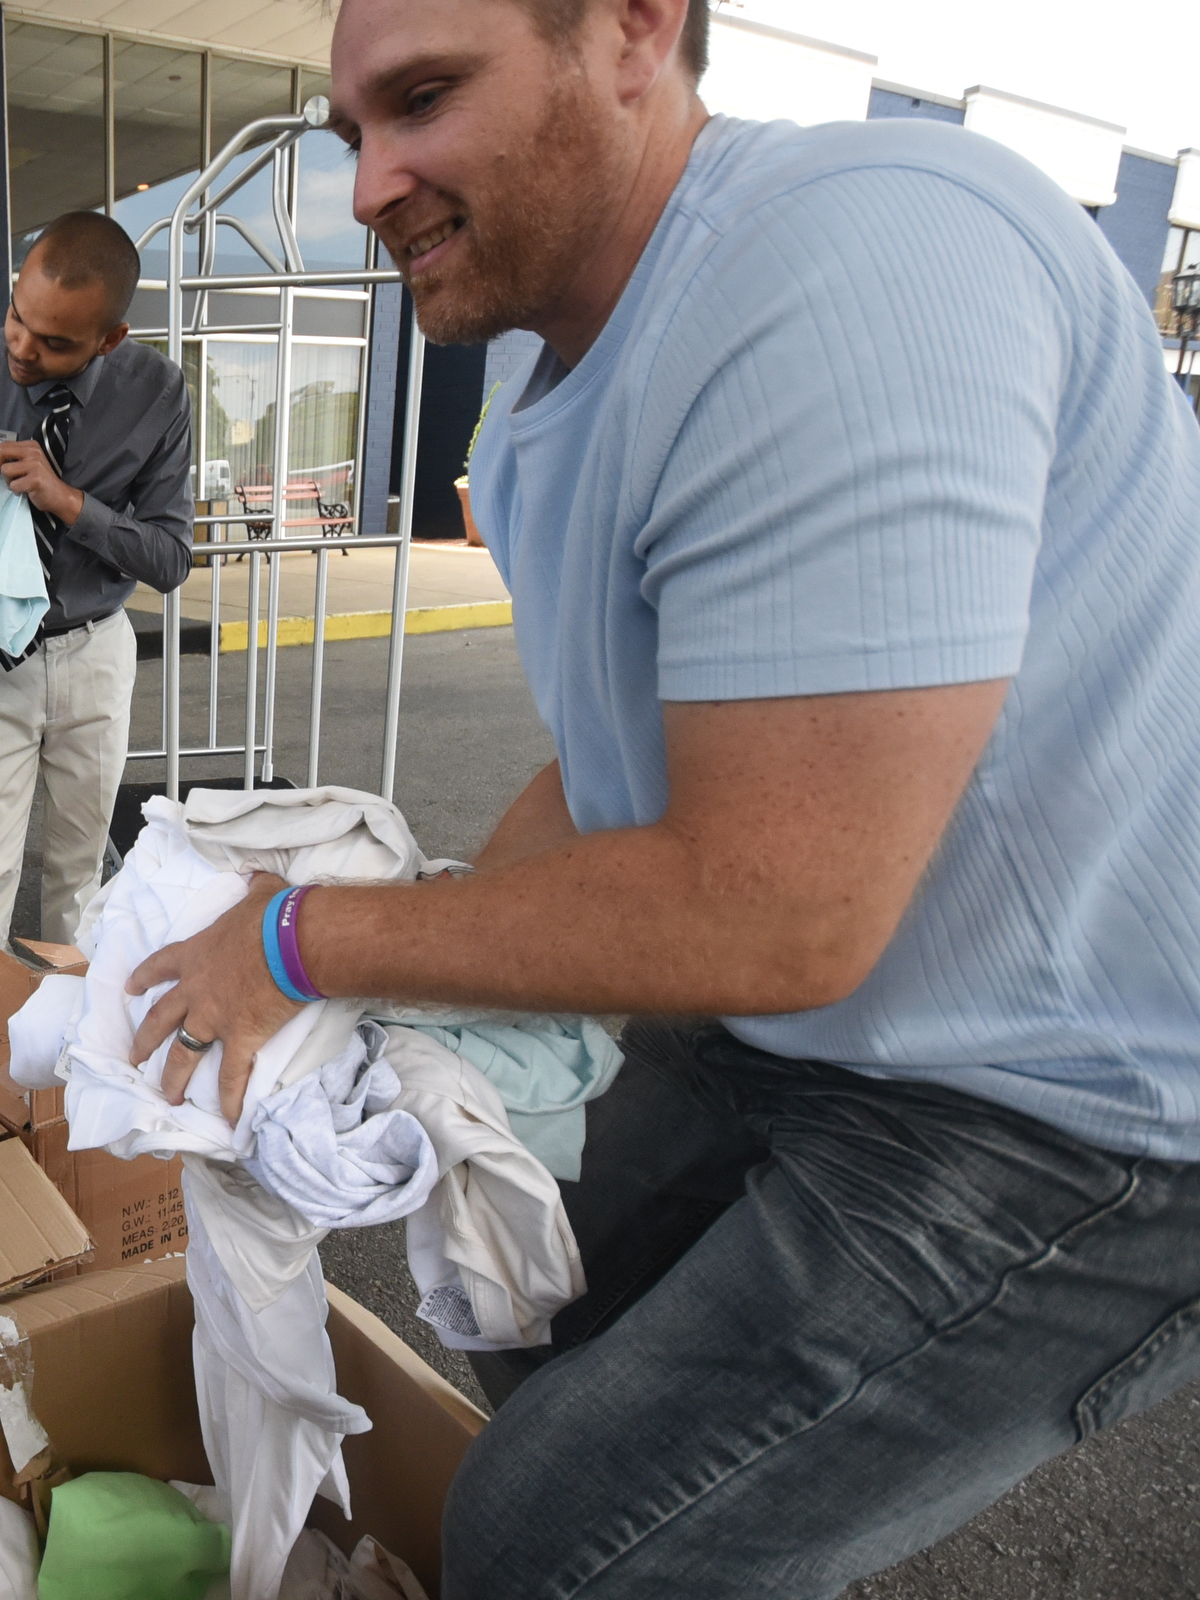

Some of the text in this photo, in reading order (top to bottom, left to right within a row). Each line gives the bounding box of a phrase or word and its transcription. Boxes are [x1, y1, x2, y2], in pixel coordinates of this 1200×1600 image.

[281, 900, 295, 927] Pray
[157, 1201, 183, 1219] 11.45
[122, 1215, 184, 1247] MEAS: 2.20
[121, 1240, 155, 1260] MADE
[160, 1232, 172, 1244] IN
